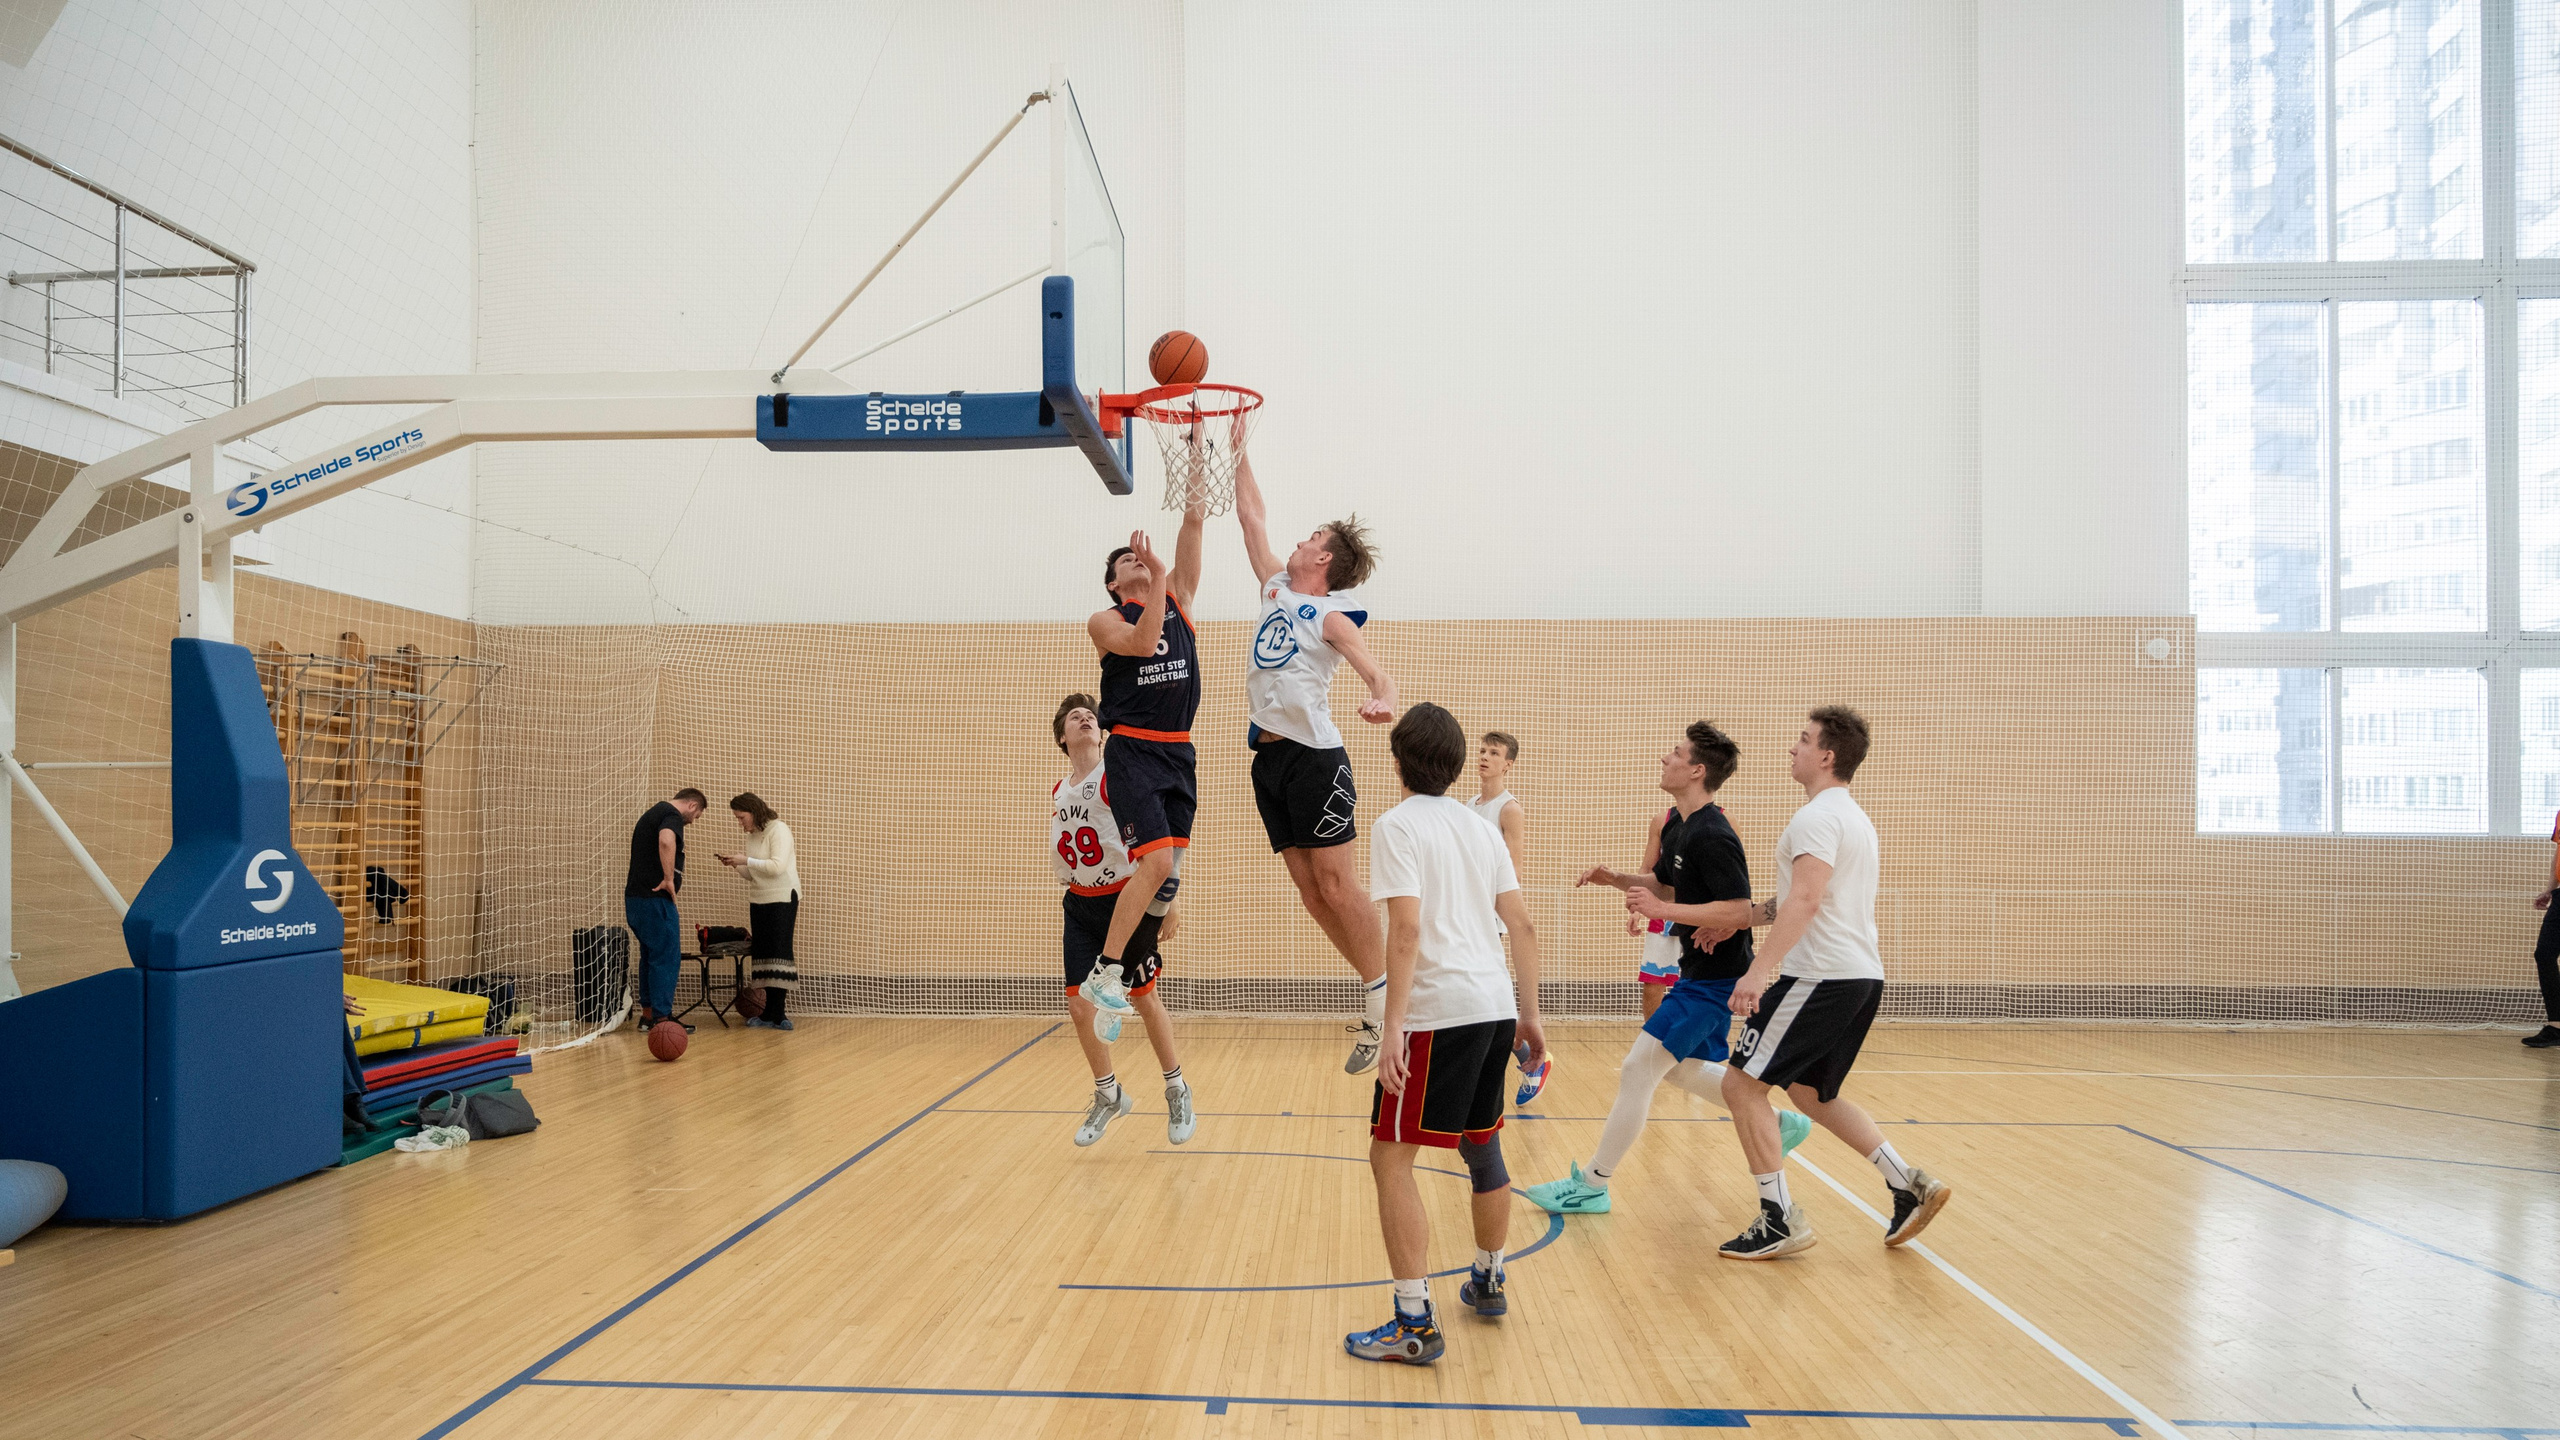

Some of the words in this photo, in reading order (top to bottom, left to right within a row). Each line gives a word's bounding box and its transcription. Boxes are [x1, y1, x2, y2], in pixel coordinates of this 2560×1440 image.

[866, 400, 962, 416] Schelde
[866, 416, 962, 435] Sports
[270, 456, 353, 496] Schelde
[356, 428, 424, 461] Sports
[377, 450, 400, 463] Superior
[408, 440, 427, 451] Design
[1266, 626, 1287, 650] 13
[1137, 669, 1189, 686] BASKETBALL
[1139, 662, 1165, 676] FIRST
[1167, 659, 1186, 671] STEP
[1058, 805, 1089, 822] OWA
[1057, 826, 1104, 869] 69
[220, 925, 274, 945] Schelde
[276, 921, 317, 941] Sports
